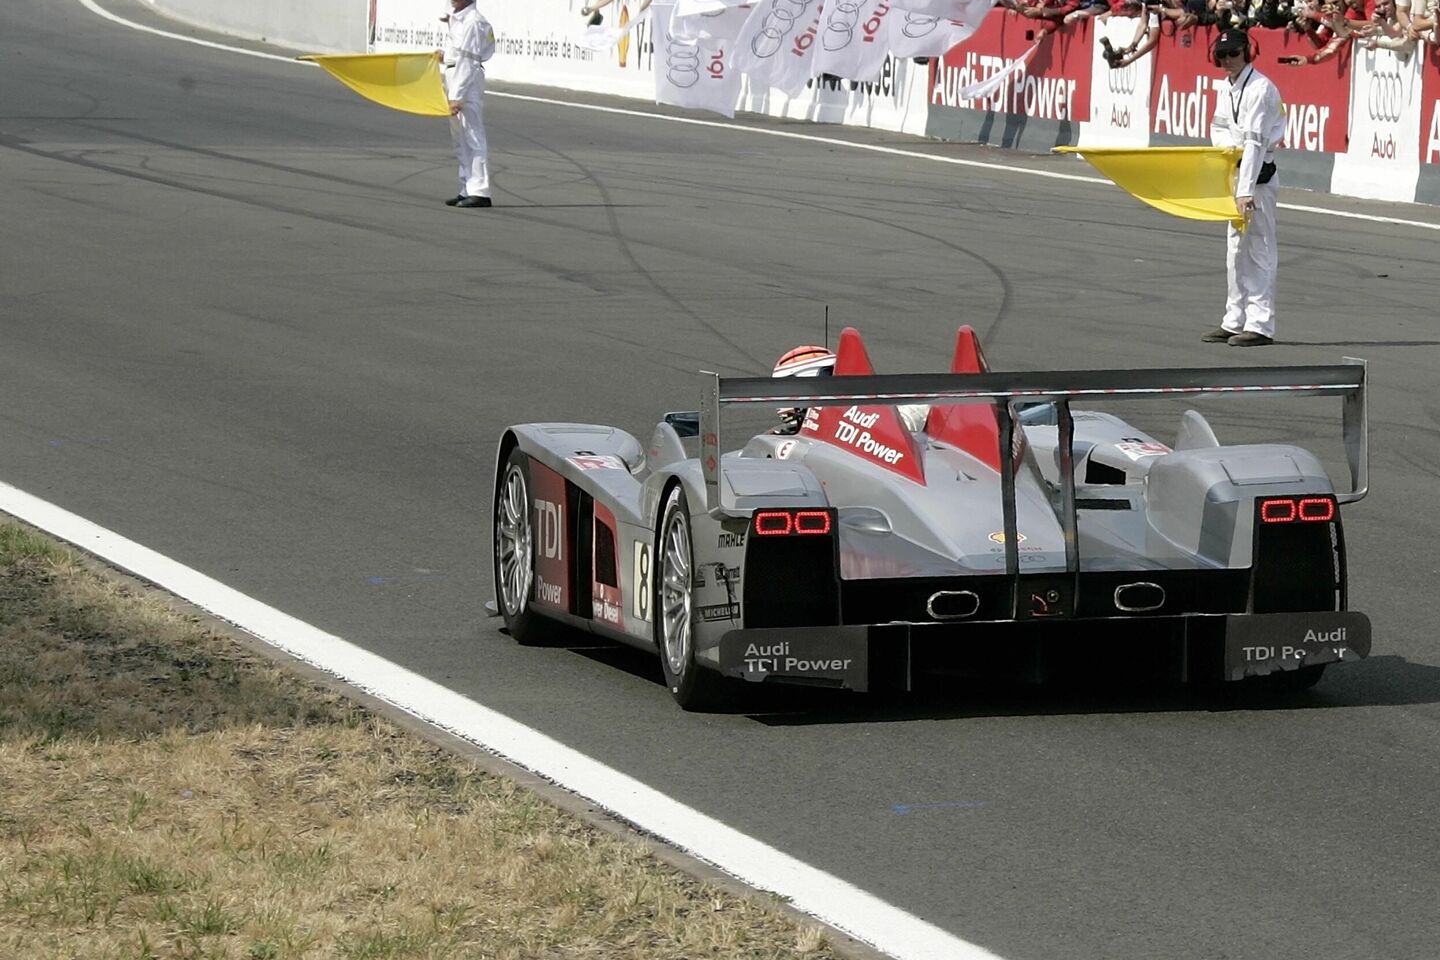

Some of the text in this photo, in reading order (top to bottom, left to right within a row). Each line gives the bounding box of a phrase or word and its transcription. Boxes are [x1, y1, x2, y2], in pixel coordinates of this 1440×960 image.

[932, 52, 977, 110] Audi
[1014, 58, 1076, 121] Power
[1110, 103, 1131, 129] Audi
[1154, 74, 1330, 152] Audi wer
[1371, 132, 1396, 160] Audi
[843, 405, 880, 429] Audi
[835, 421, 904, 465] TDI Power
[535, 498, 562, 561] TDI
[717, 533, 745, 549] MAHLE
[537, 575, 562, 604] Power
[640, 542, 649, 621] 8
[1303, 627, 1346, 643] Audi
[744, 641, 789, 657] Audi
[1242, 646, 1275, 661] TDI
[785, 657, 852, 672] Power
